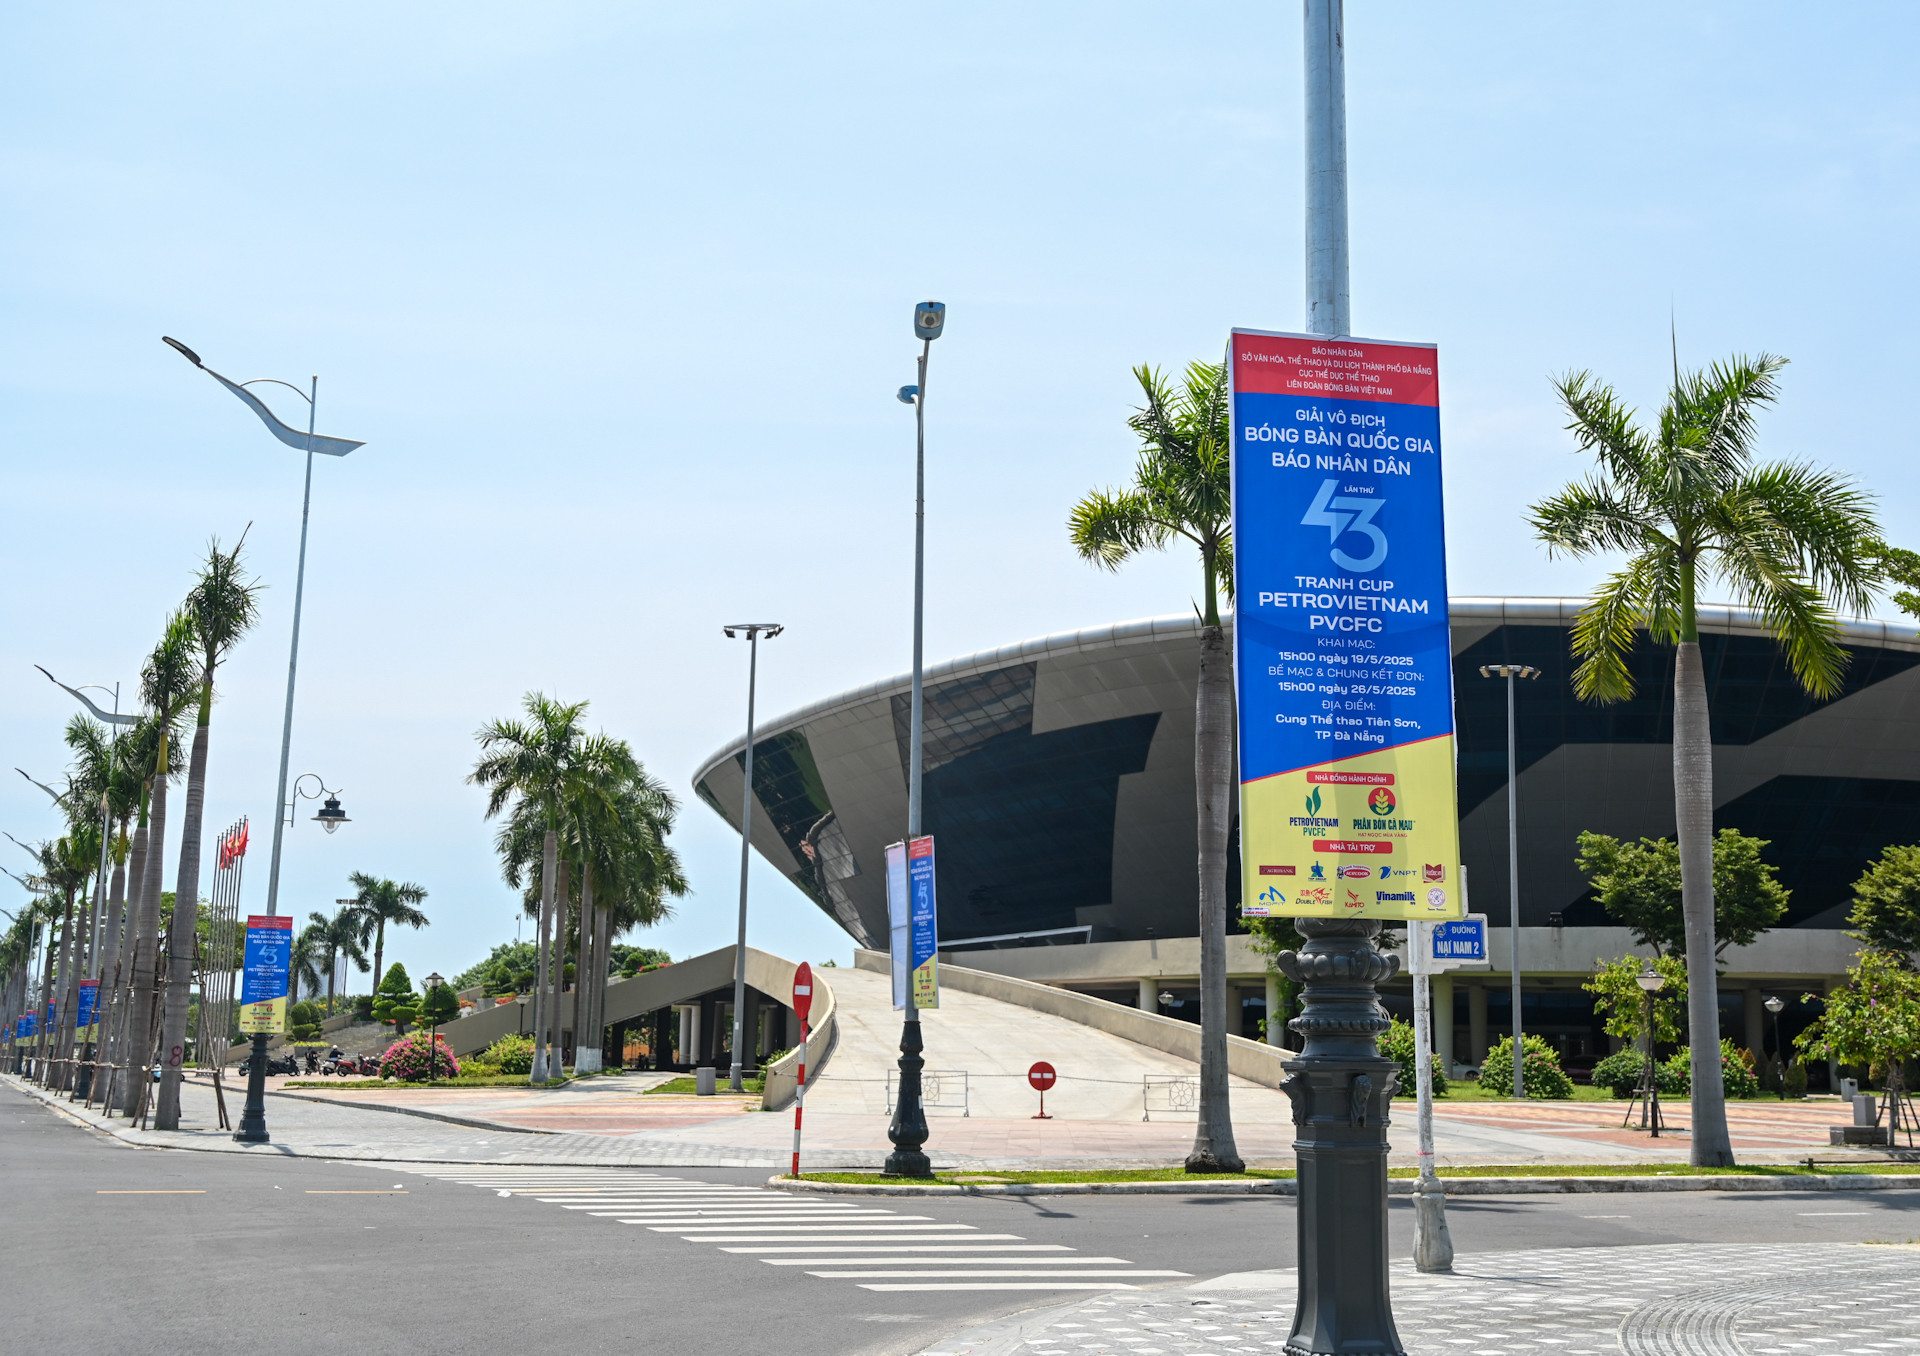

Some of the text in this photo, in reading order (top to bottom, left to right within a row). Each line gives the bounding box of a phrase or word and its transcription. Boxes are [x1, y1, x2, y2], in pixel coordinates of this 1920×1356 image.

[1312, 346, 1363, 358] BÁO NHÂN DÂN
[1242, 351, 1432, 375] SỞ VĂN HÓA, THỂ THAO VÀ DU LỊCH THÀNH PHỐ ĐÀ NẴNG
[1298, 368, 1380, 383] CỤC THỂ DỤC THỂ THAO
[1286, 378, 1393, 396] LIÊN ĐOÀN BÓNG BÀN VIỆT NAM
[1295, 406, 1386, 429] GIẢI VÔ ĐỊCH
[1245, 422, 1435, 454] BÓNG BÀN QUỐC GIA
[1272, 448, 1411, 476] BÁO NHÂN DÂN
[1300, 478, 1389, 573] 43
[1294, 575, 1394, 592] TRANH CUP
[1258, 591, 1429, 614] PETROVIETNAM
[1309, 614, 1383, 633] PVCFC
[1317, 637, 1376, 651] KHAI MẠC:
[1278, 651, 1414, 666] 15h00 ngày 19/5/2025
[1268, 663, 1425, 682] BẾ MẠC & CHUNG KẾT ĐƠN:
[1278, 681, 1416, 697] 15h00 ngày 26/5/2025
[1321, 698, 1376, 712] ĐỊA ĐIỂM:
[1275, 712, 1422, 730] Cung Thể thao Tiên Sơn,
[1315, 729, 1385, 744] TP Đà Nẵng
[1315, 772, 1387, 784] NHÀ ĐỒNG HÀNH CHÍNH
[1289, 816, 1339, 828] PETROVIETNAM
[1353, 817, 1413, 831] PHÂN BÓN CÀ MAU
[1302, 827, 1326, 837] PVCFC
[1329, 842, 1376, 853] NHÀ TÀI TRỢ
[1376, 891, 1415, 902] Vinamilk
[1452, 924, 1477, 934] ĐƯỜNG
[1453, 941, 1472, 954] NAM
[1473, 941, 1480, 954] 2
[169, 1045, 183, 1067] 8
